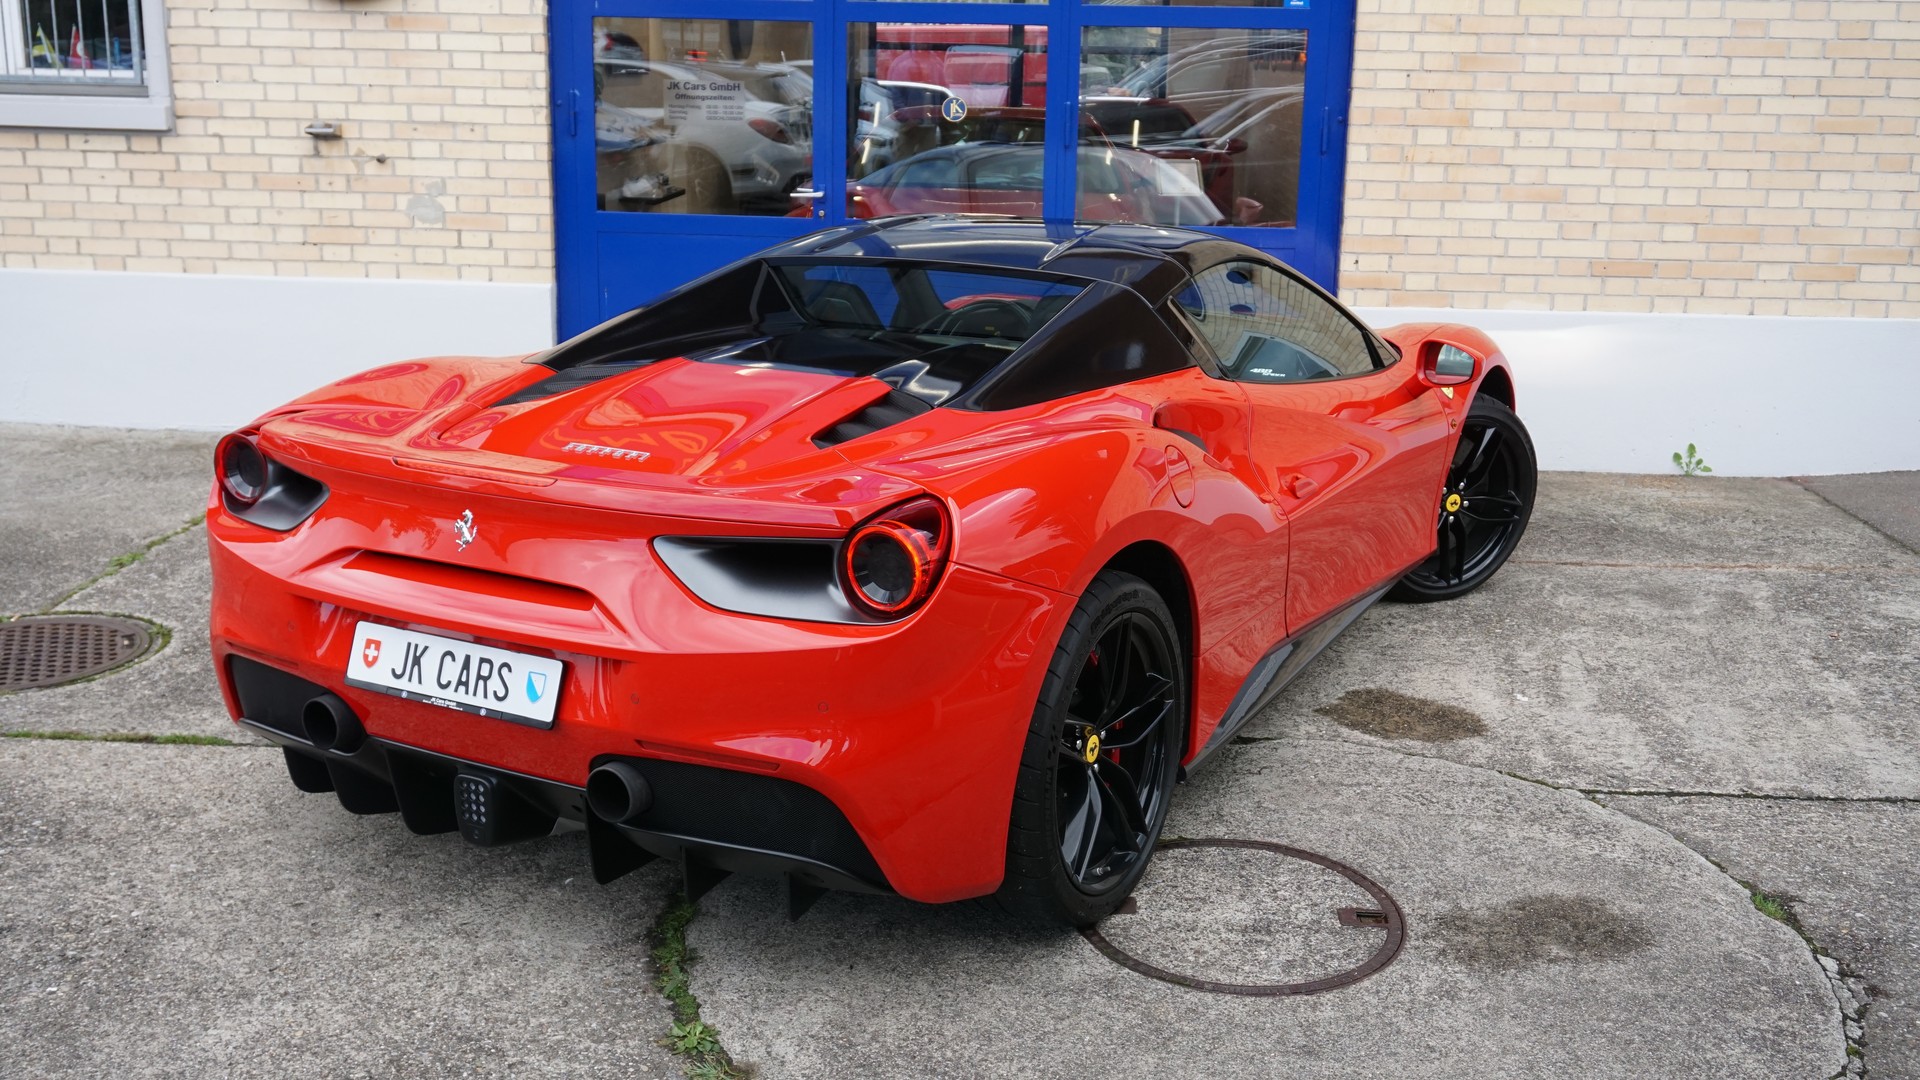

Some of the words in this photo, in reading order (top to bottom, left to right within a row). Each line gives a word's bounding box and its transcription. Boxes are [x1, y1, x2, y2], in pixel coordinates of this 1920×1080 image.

[667, 81, 680, 90] JK
[683, 82, 706, 91] Cars
[709, 82, 741, 91] GmbH
[391, 641, 429, 685] JK
[436, 650, 513, 702] CARS
